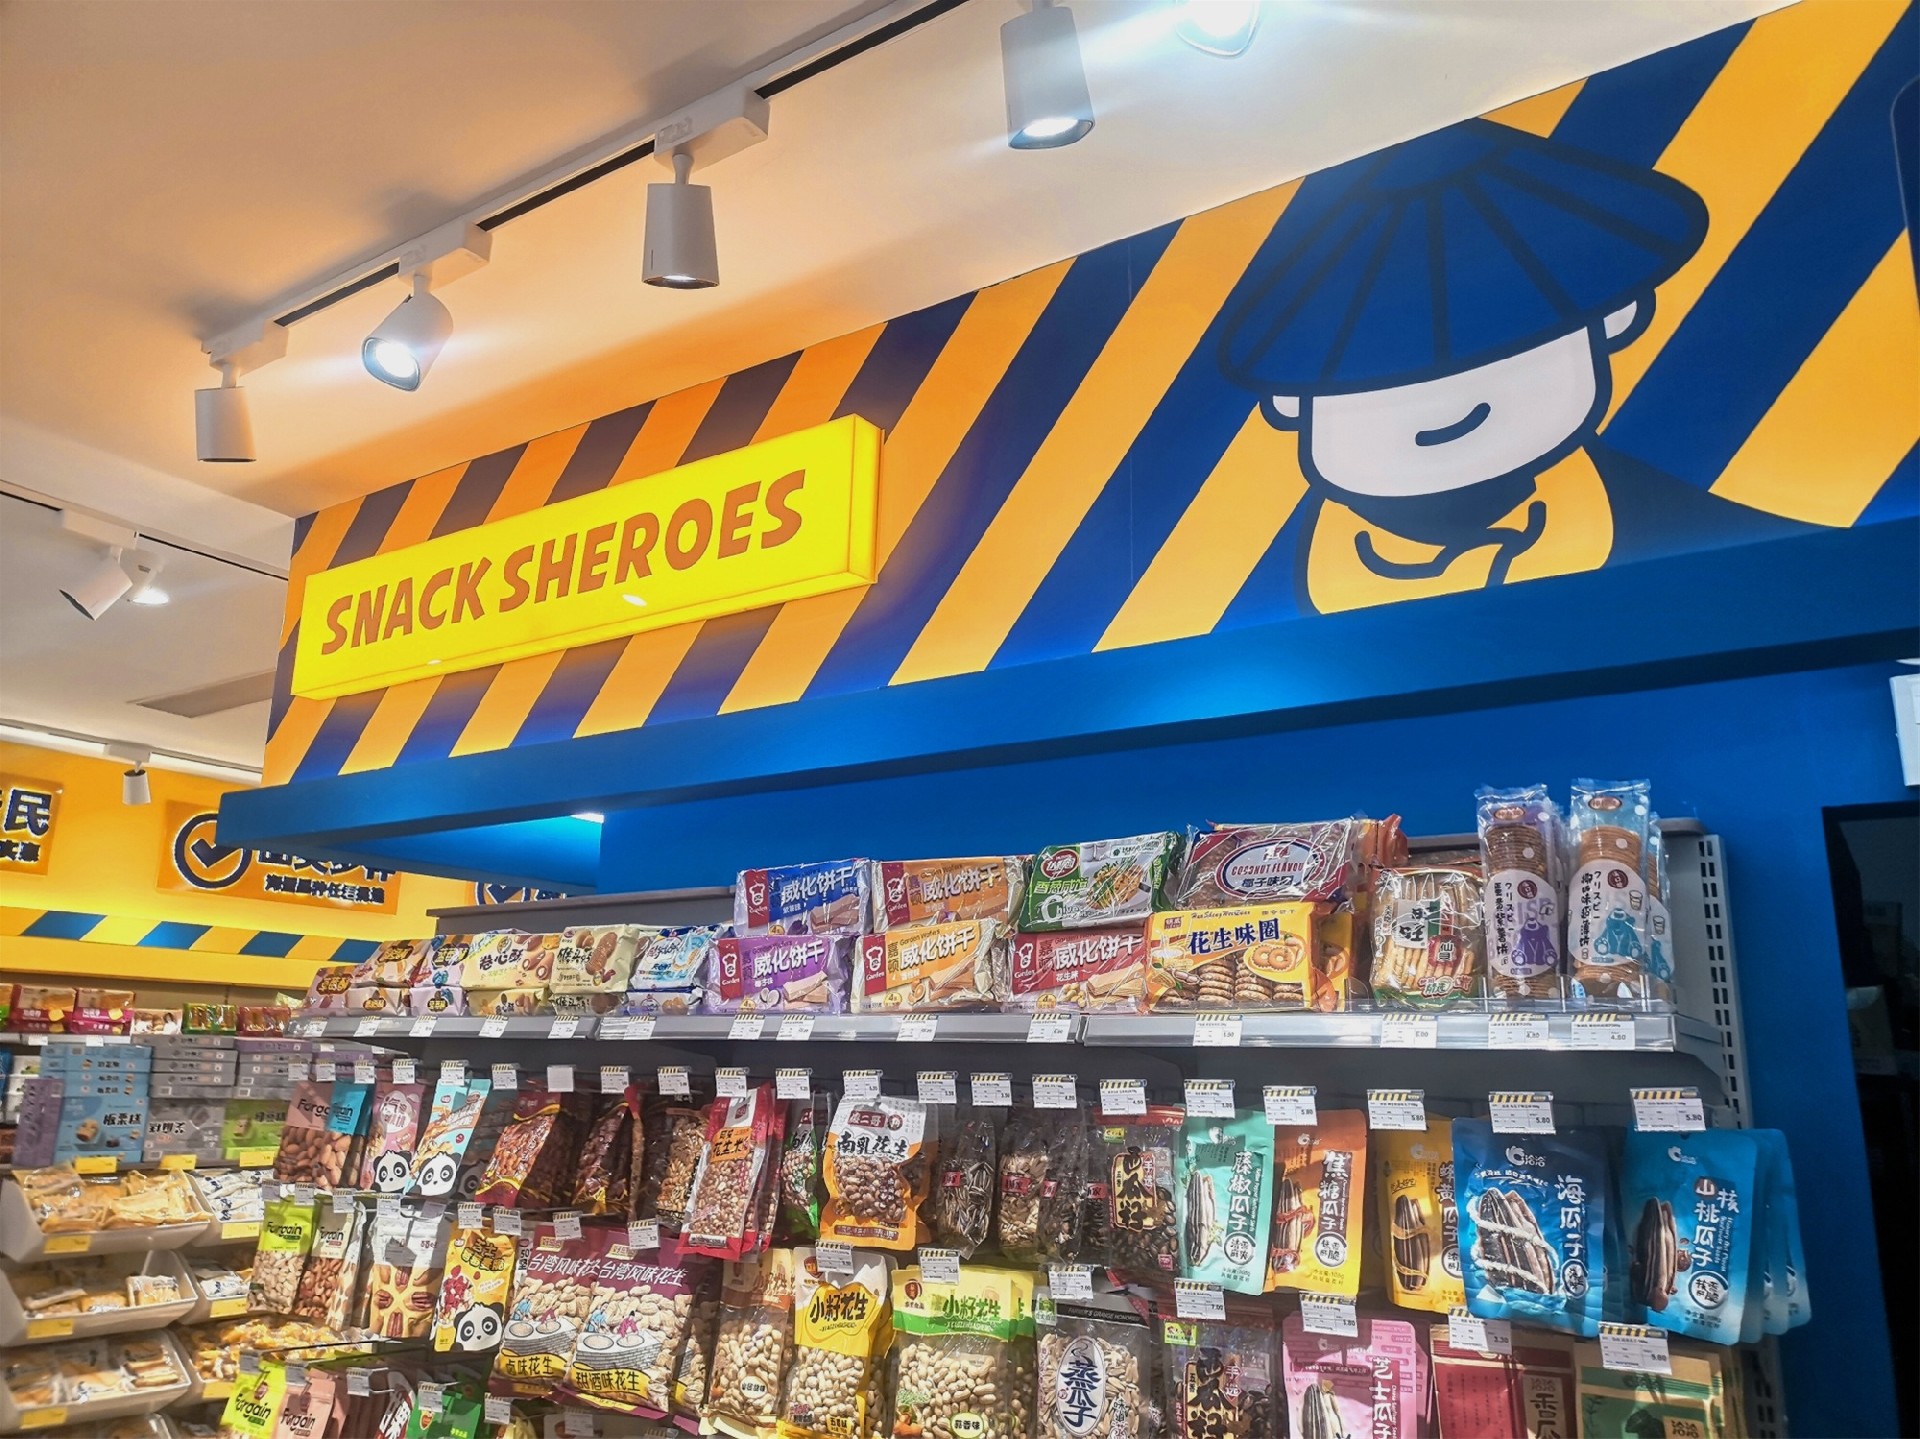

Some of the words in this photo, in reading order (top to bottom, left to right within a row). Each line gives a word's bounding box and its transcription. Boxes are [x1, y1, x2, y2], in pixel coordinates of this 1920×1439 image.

[321, 557, 493, 656] SNACK
[499, 469, 806, 613] SHEROES
[781, 866, 853, 906] 威化饼干
[923, 864, 1001, 903] 威化饼干
[1231, 864, 1271, 876] COCONUT
[1272, 862, 1306, 874] FLAVOU
[1592, 870, 1602, 919] クリスピー
[900, 926, 975, 971] 威化饼干
[1054, 934, 1142, 971] 威化饼干
[1188, 918, 1279, 955] 花生味圈
[753, 940, 825, 979] 威化饼干
[1055, 970, 1079, 982] 花生味
[837, 1131, 909, 1157] 南乳花生
[1228, 1151, 1253, 1231] 藤椒瓜子
[1319, 1151, 1348, 1231] 焦糖瓜子
[598, 1260, 688, 1287] 台湾风味花生
[809, 1291, 869, 1324] 小籽花生
[942, 1294, 1002, 1321] 小籽花生
[576, 1371, 642, 1392] 甜酒味花生
[1060, 1355, 1101, 1428] 蒸瓜子
[235, 1393, 271, 1418] Fargain
[281, 1408, 316, 1431] Fargain
